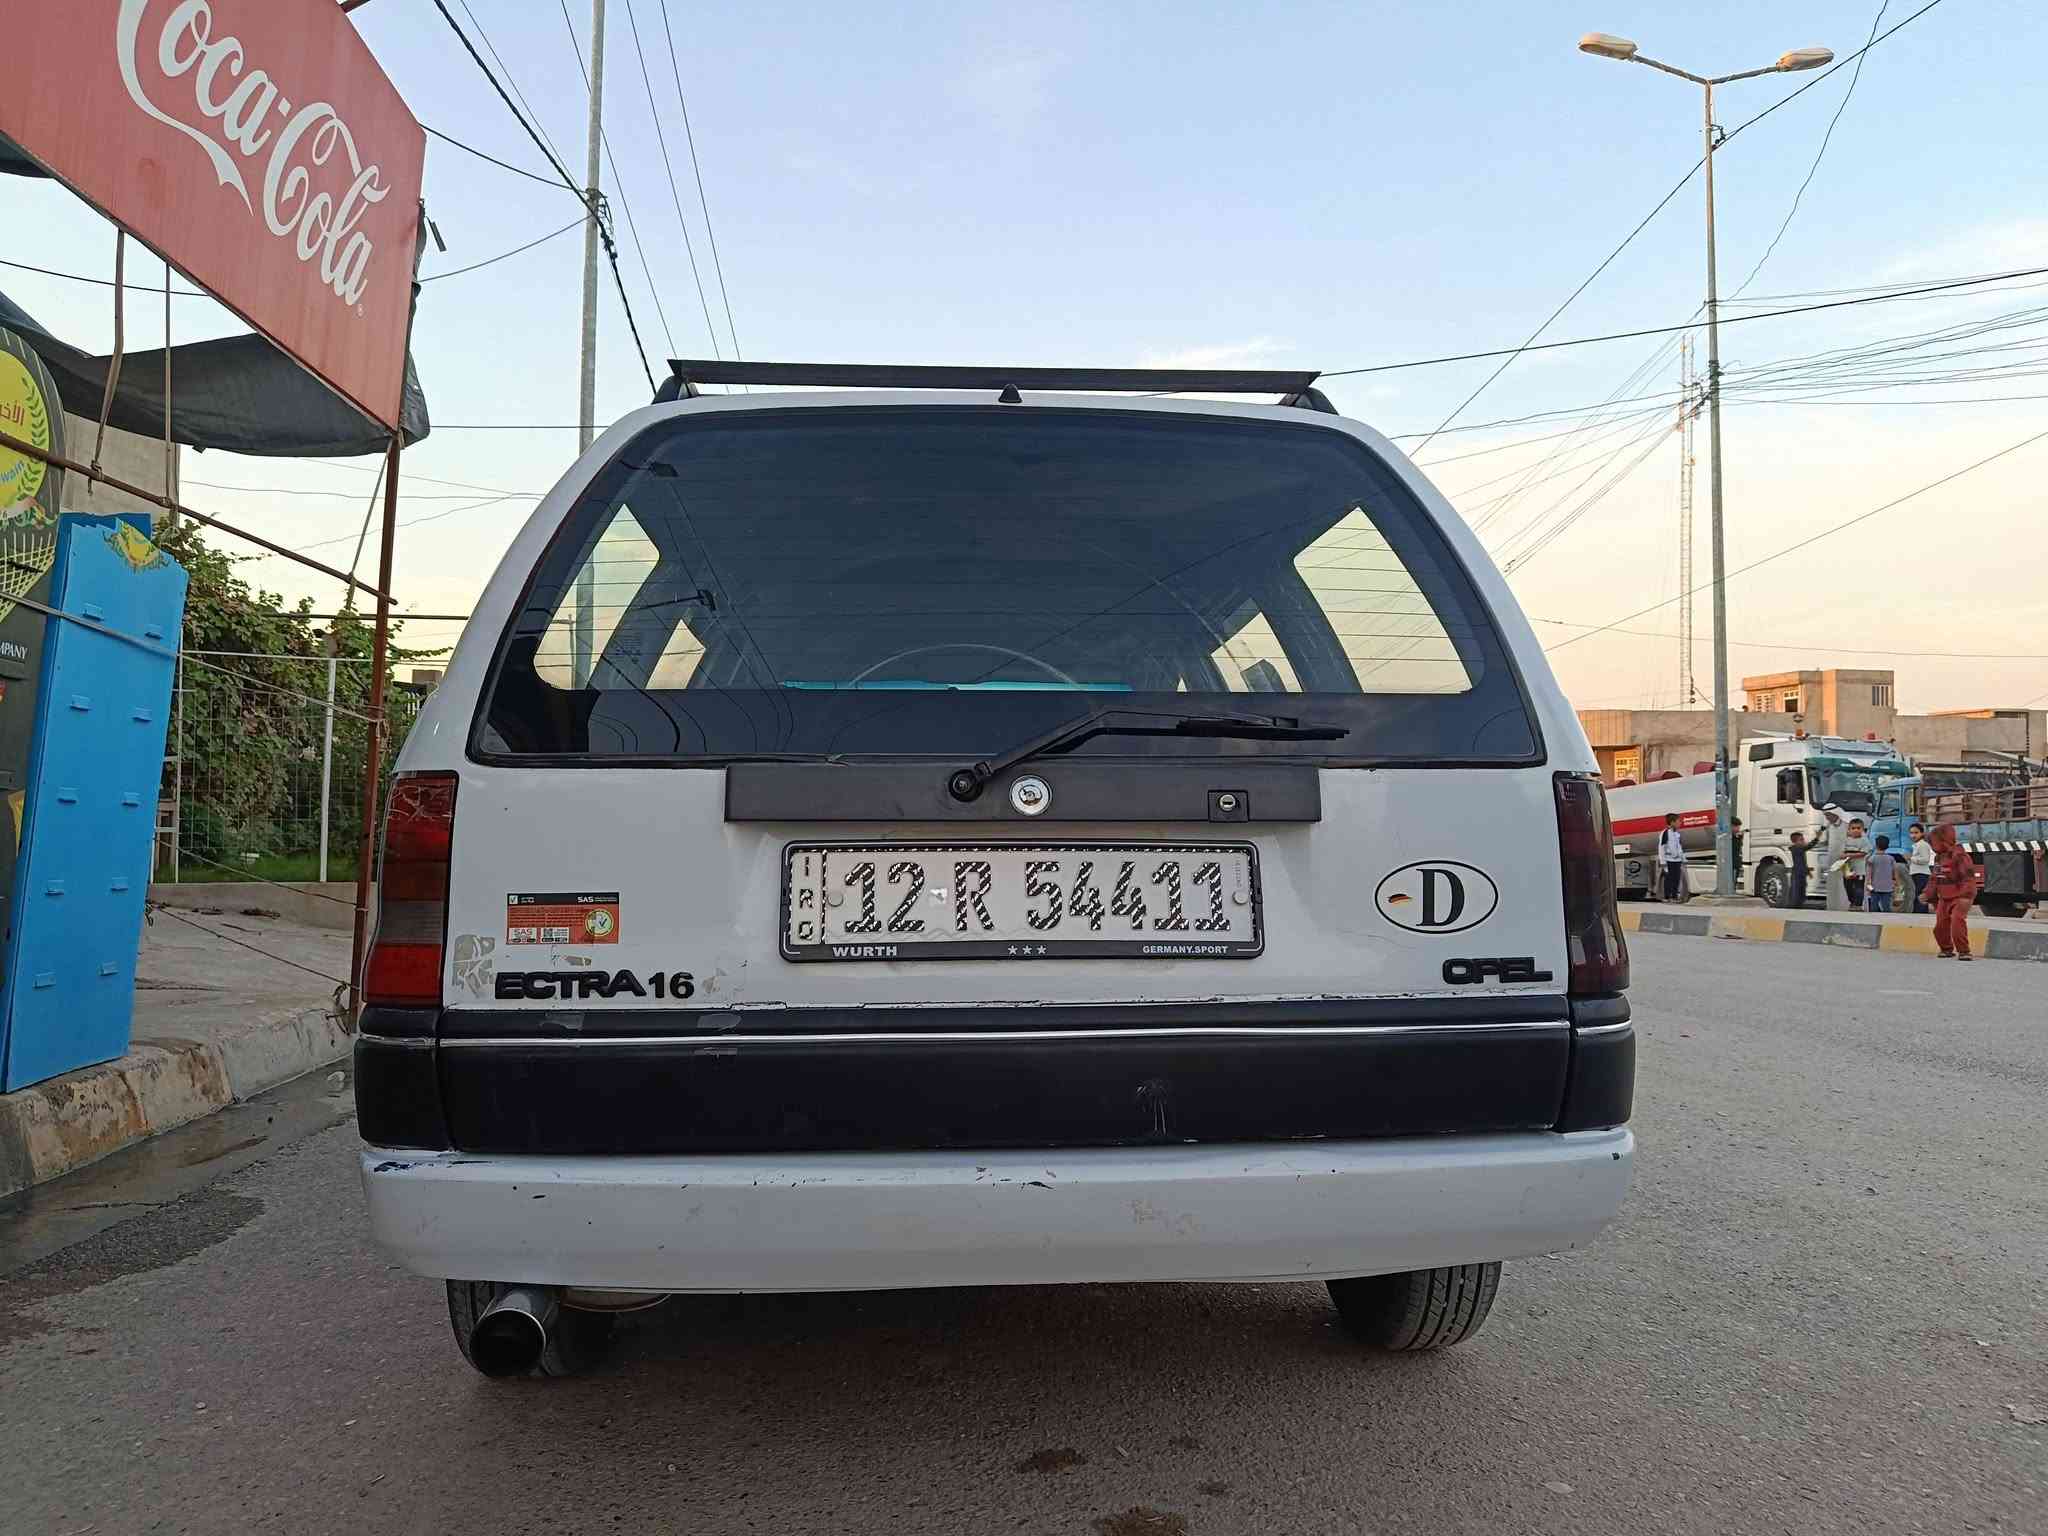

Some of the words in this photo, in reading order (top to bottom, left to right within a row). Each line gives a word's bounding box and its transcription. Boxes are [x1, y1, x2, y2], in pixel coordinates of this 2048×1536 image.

[845, 861, 925, 932] 12
[955, 861, 994, 930] R
[1025, 861, 1231, 931] 54411
[1416, 868, 1465, 926] D
[832, 946, 898, 957] WURTH
[495, 969, 647, 999] ECTRA
[648, 972, 695, 999] 16
[1443, 957, 1553, 985] OPEL
